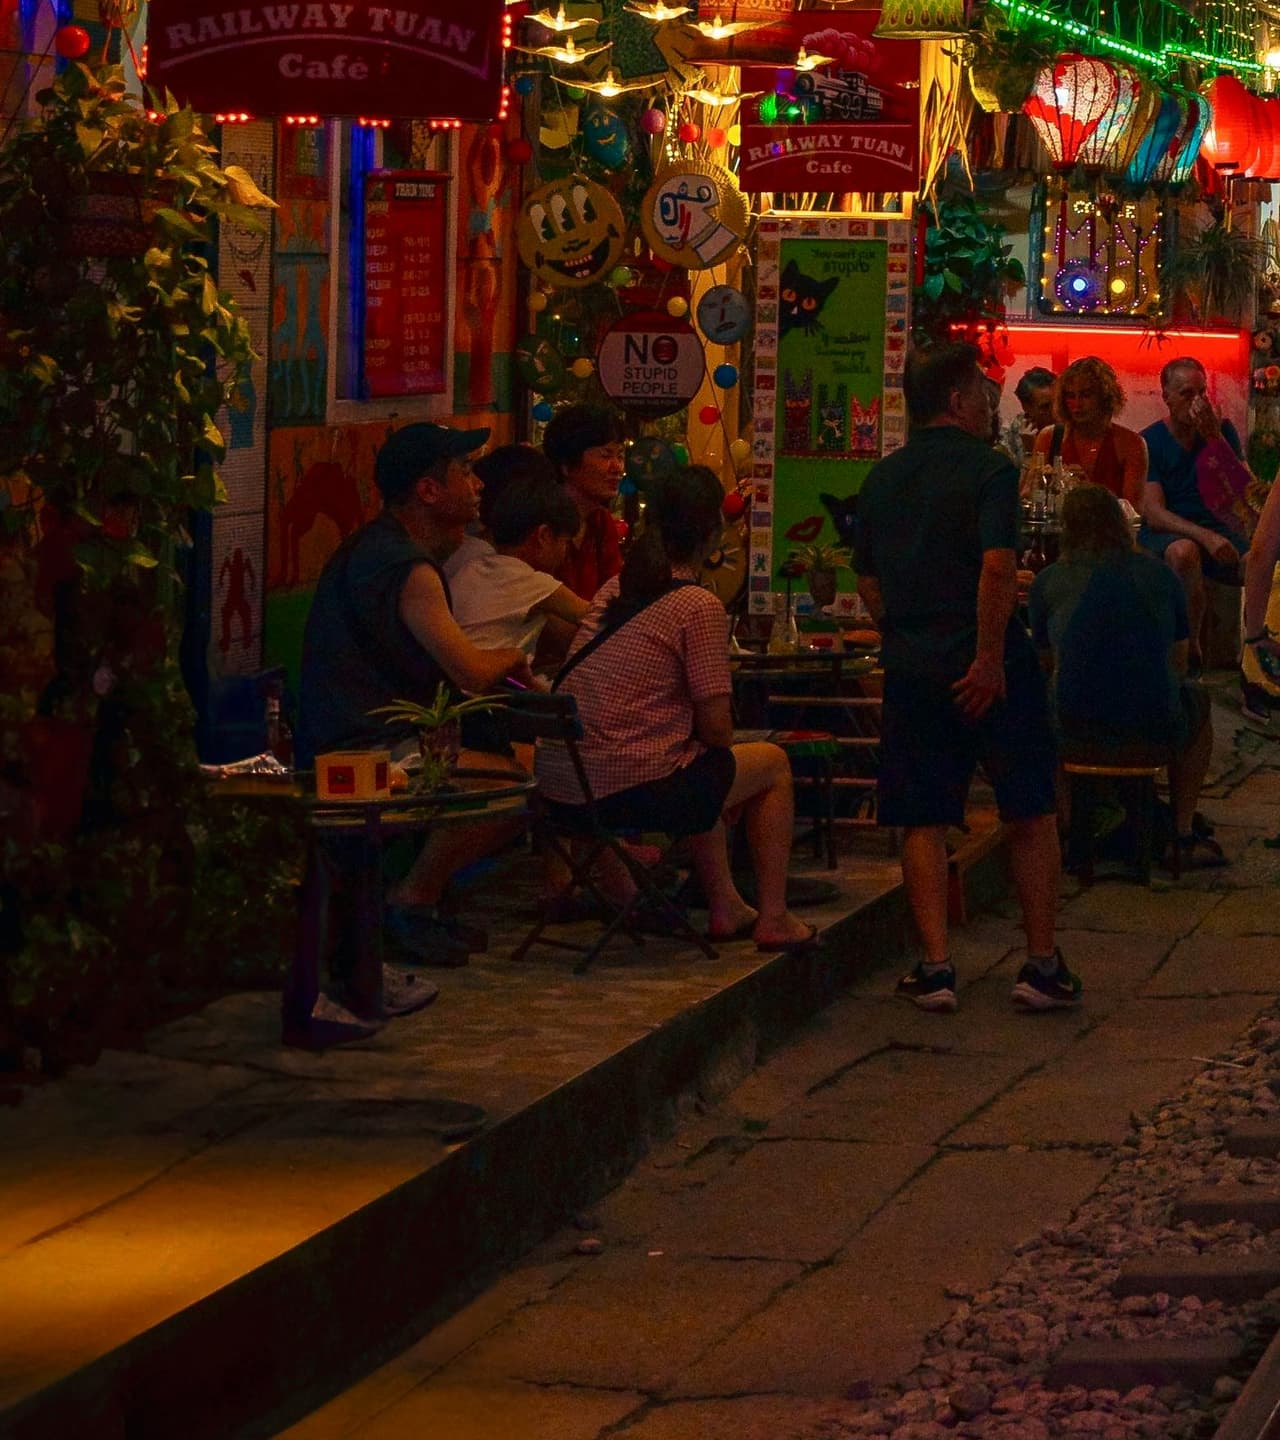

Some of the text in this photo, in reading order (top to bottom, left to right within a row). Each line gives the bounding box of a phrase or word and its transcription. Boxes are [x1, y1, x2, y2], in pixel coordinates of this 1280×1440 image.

[165, 2, 477, 53] RAILWAY TUAN
[850, 135, 906, 158] TUAN
[624, 334, 679, 365] NO
[624, 367, 678, 380] STUPID
[623, 381, 678, 395] PEOPLE
